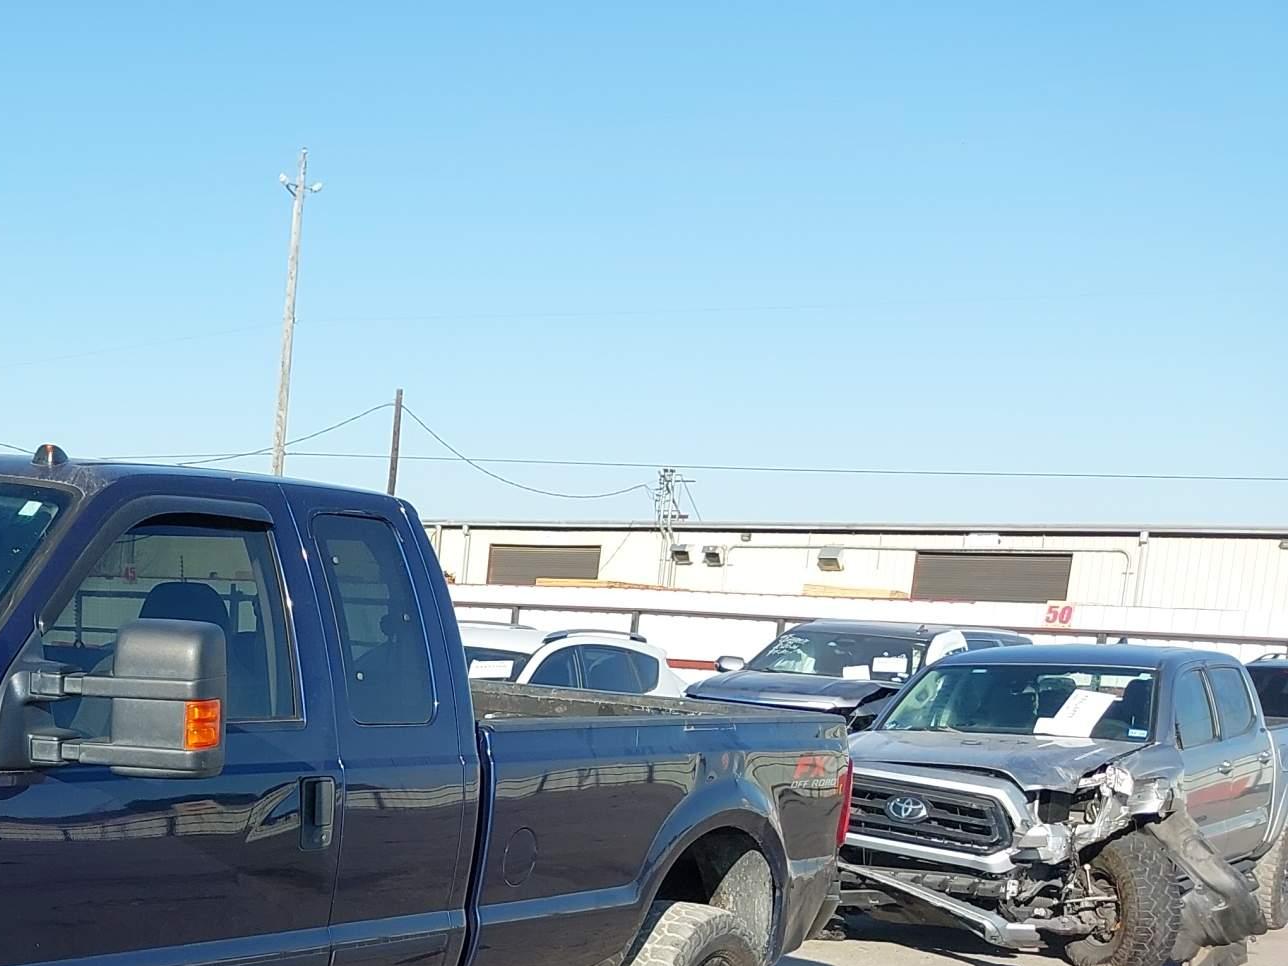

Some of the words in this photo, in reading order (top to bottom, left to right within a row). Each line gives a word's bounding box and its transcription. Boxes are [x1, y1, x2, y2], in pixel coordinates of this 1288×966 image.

[1045, 605, 1073, 624] 50
[790, 780, 810, 789] OFF
[811, 777, 838, 787] ROAD
